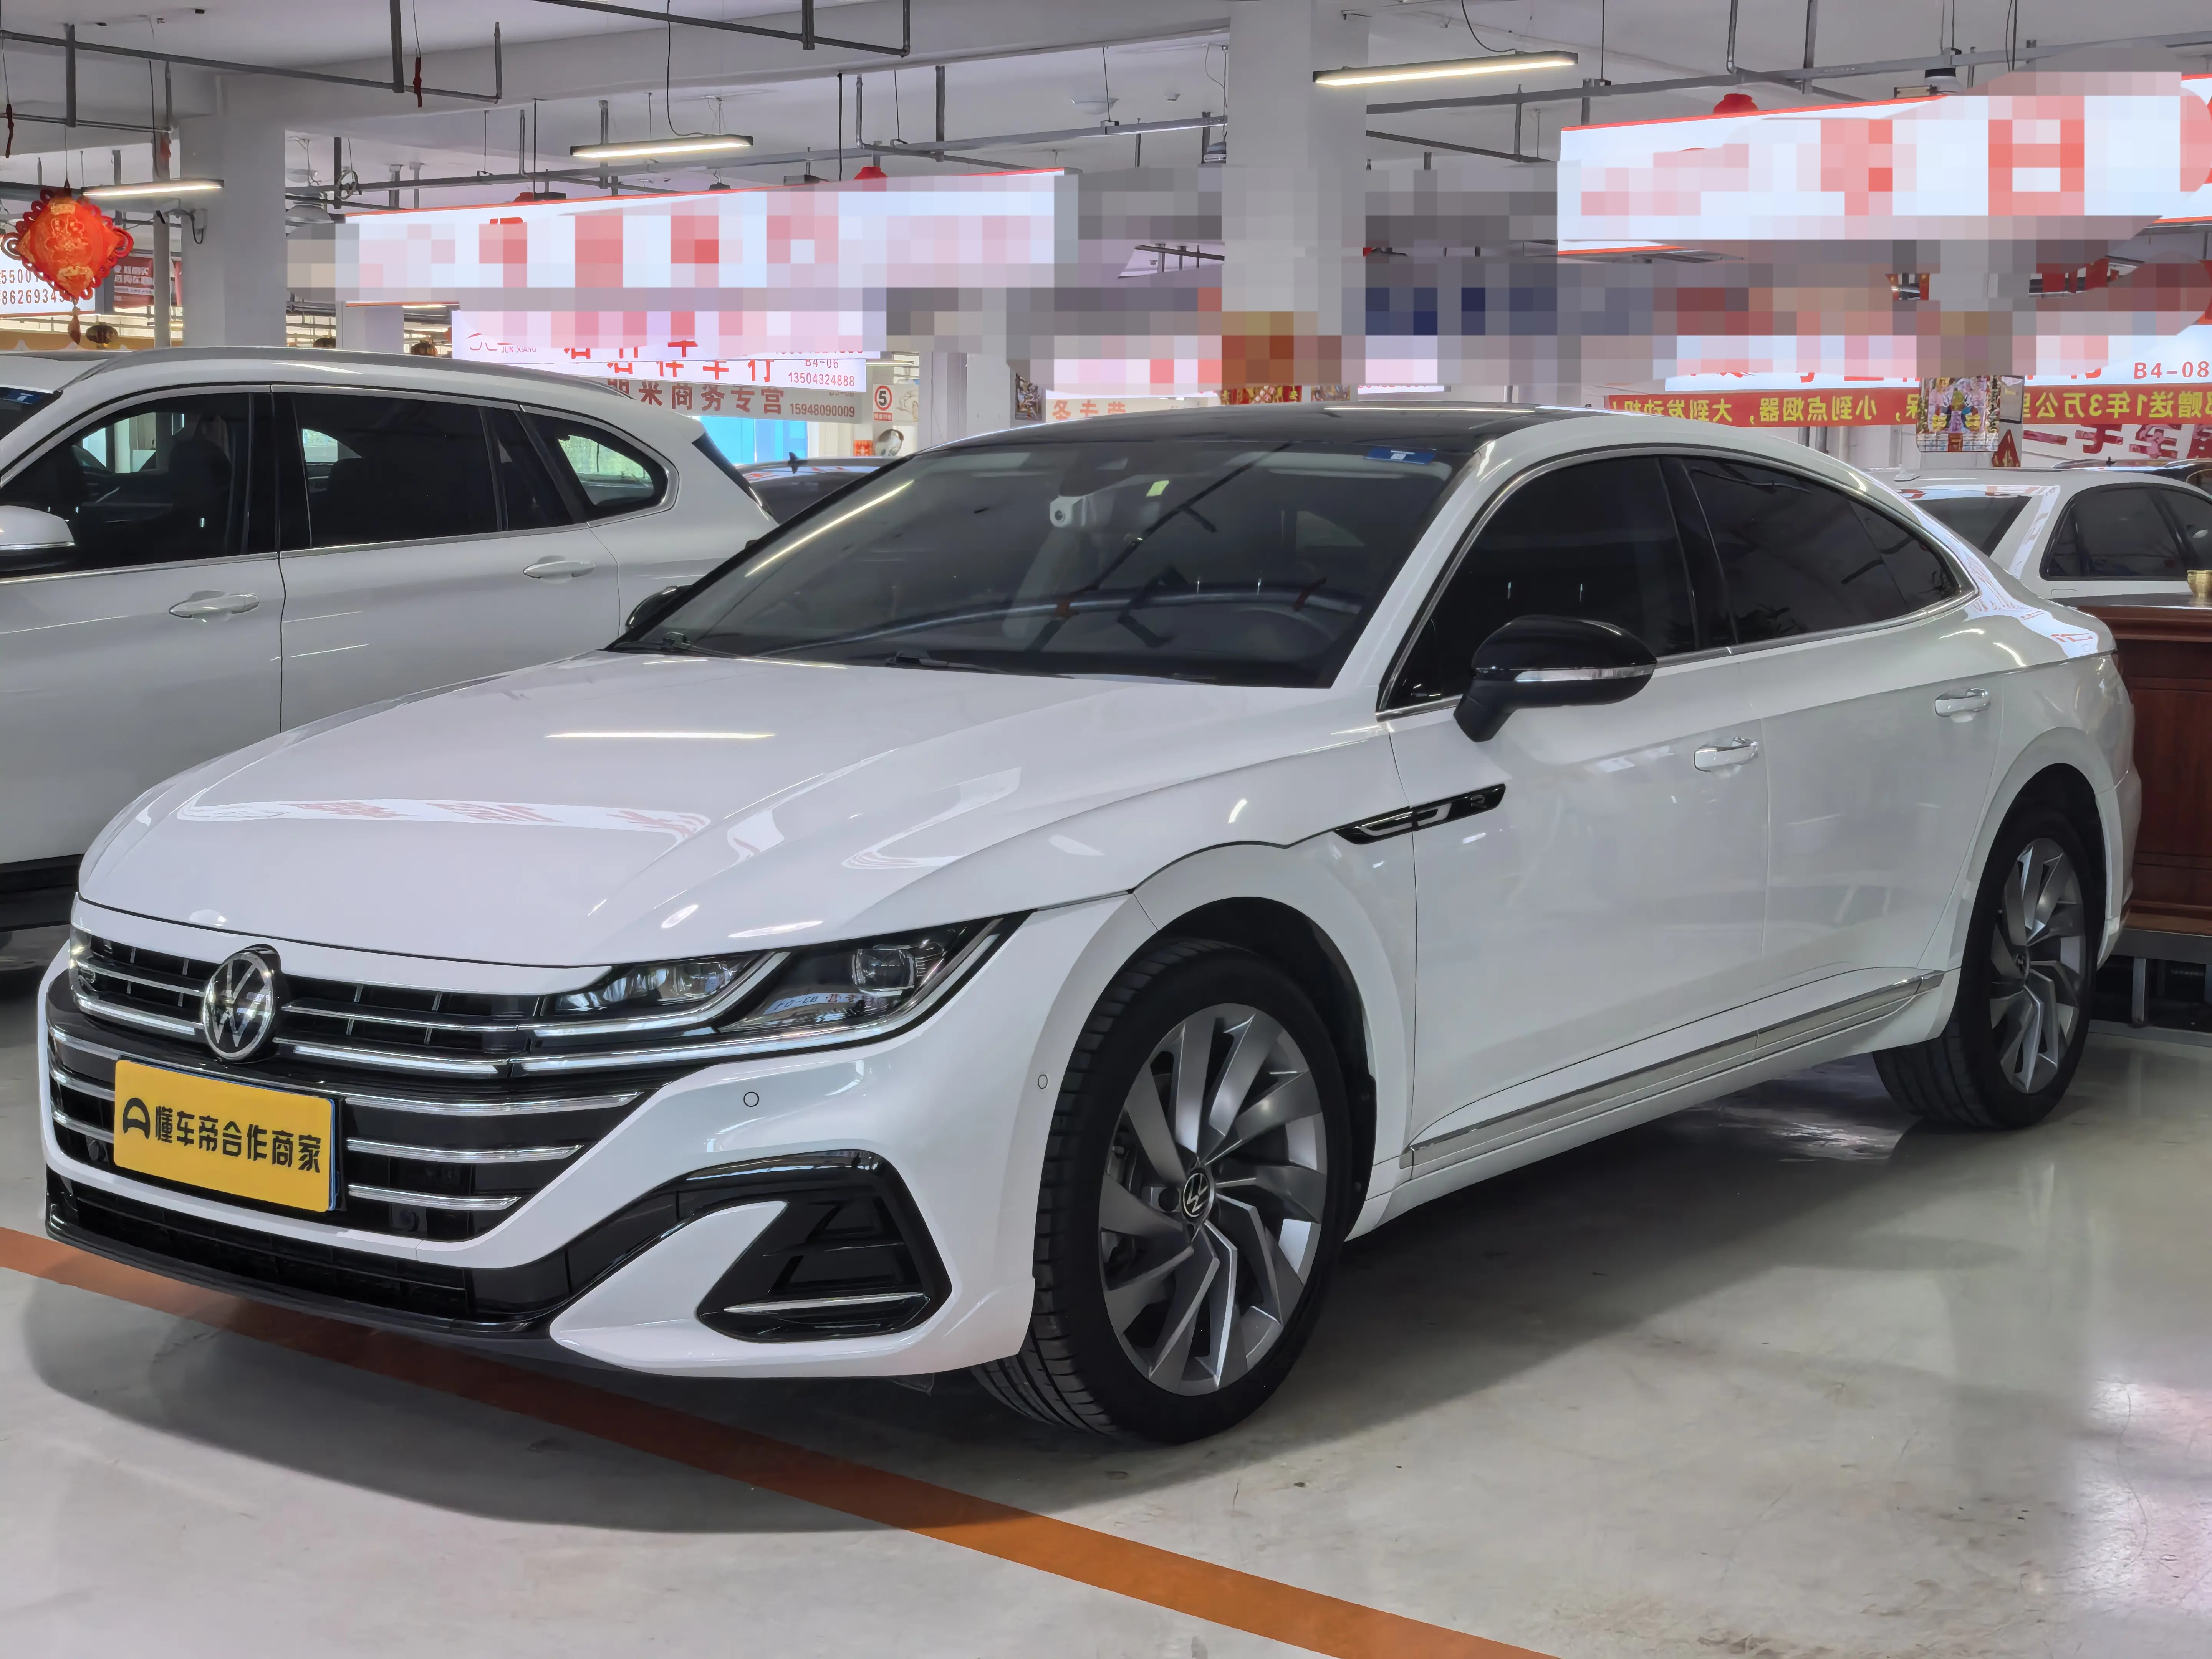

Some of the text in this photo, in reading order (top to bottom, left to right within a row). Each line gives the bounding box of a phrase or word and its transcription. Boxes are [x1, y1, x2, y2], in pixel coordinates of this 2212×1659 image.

[0, 269, 38, 284] 5500
[0, 289, 64, 305] 8626934
[2134, 361, 2209, 379] B4-08
[788, 372, 854, 387] 13504324888
[878, 390, 887, 406] 5
[790, 403, 855, 417] 15948090009
